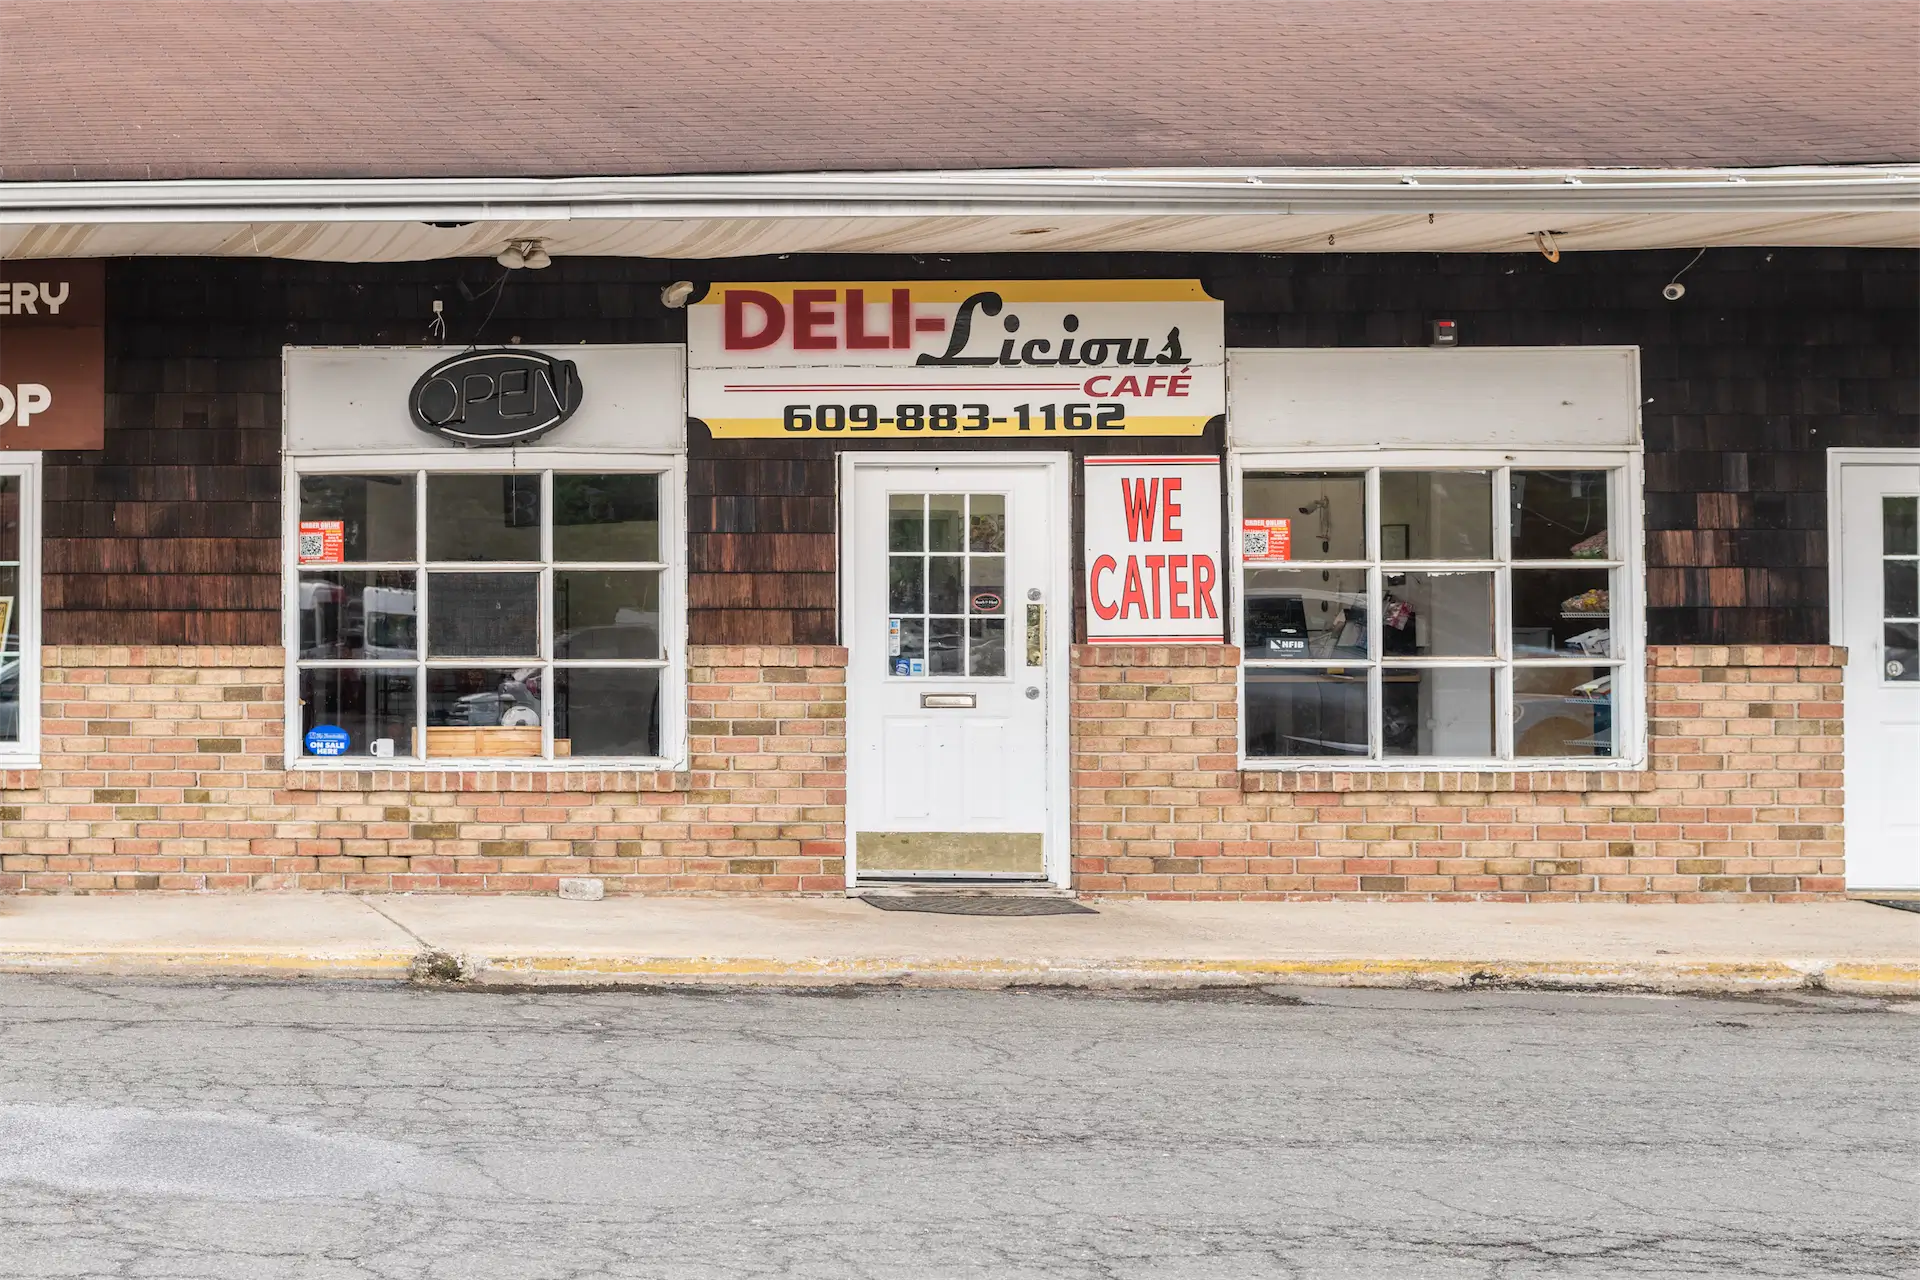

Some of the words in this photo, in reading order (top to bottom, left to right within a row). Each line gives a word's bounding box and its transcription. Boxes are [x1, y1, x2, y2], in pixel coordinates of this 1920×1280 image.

[417, 365, 571, 426] OPEN
[1083, 366, 1192, 398] CAFÉ
[783, 403, 1126, 432] 609-883-1162
[1121, 477, 1183, 542] WE
[1090, 554, 1218, 620] CATER
[1281, 640, 1304, 649] NFIB
